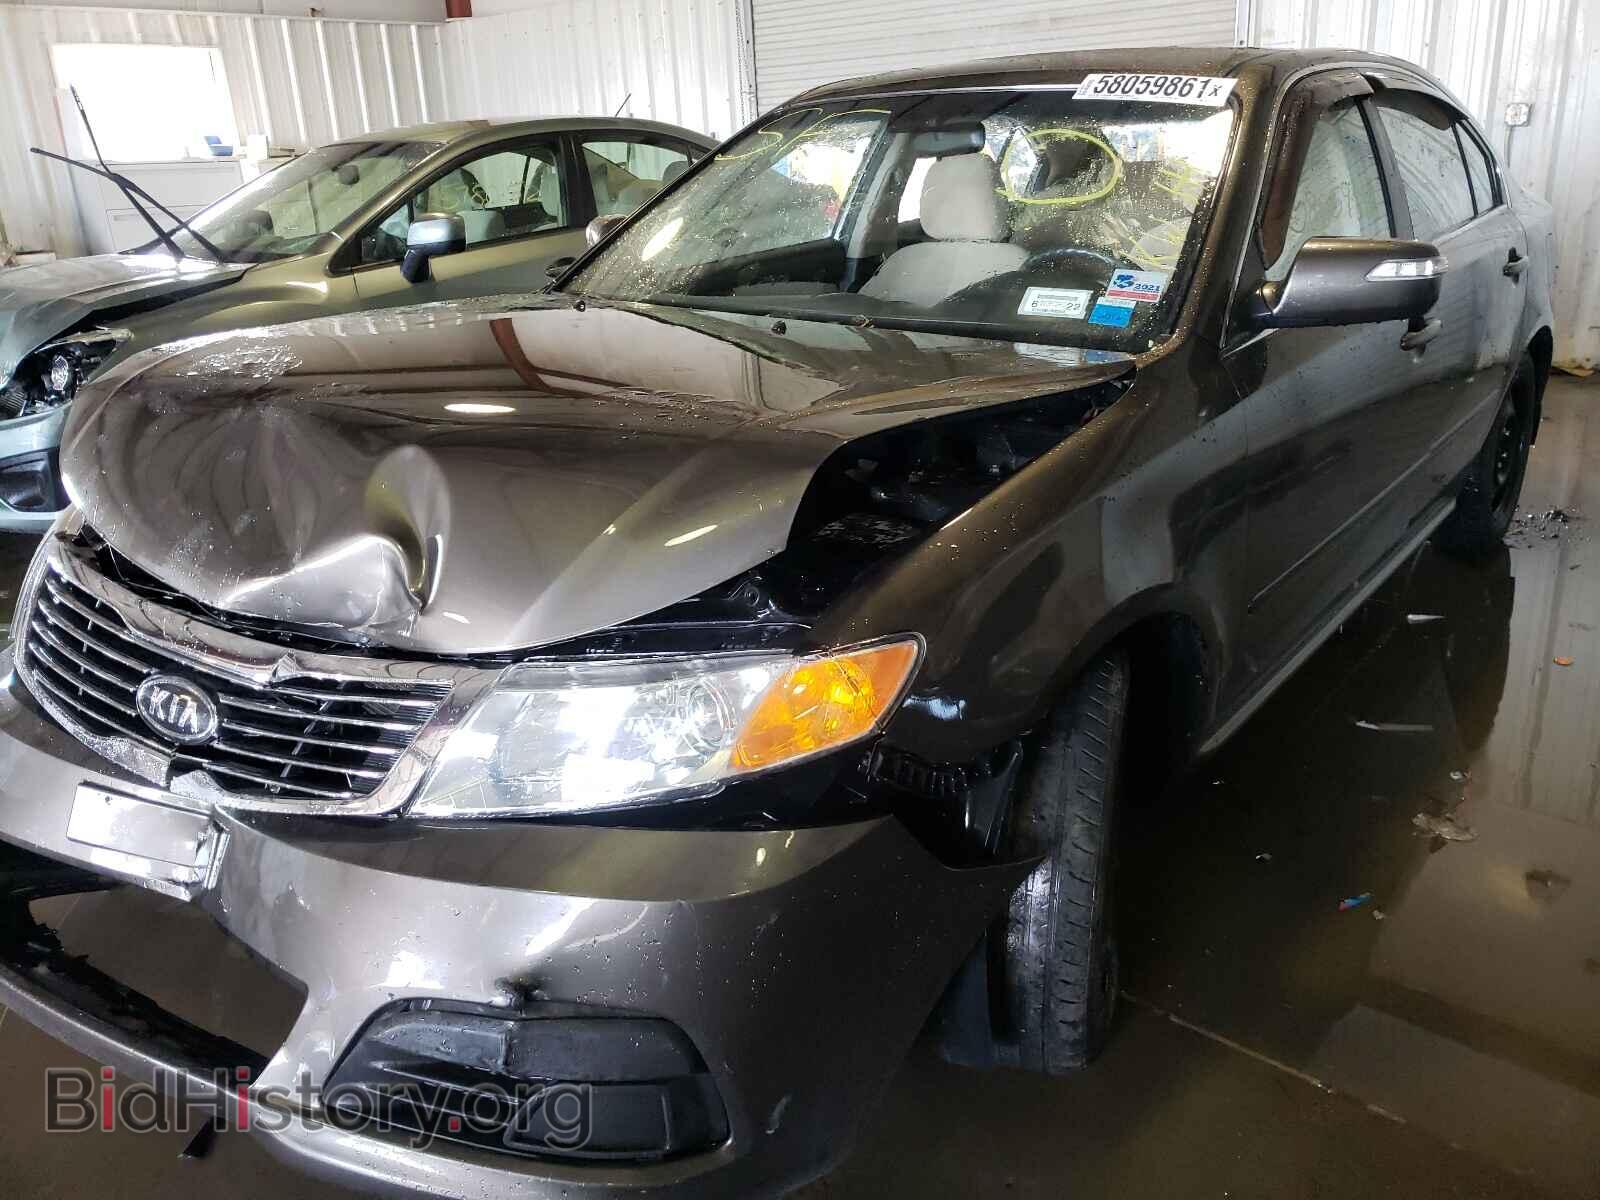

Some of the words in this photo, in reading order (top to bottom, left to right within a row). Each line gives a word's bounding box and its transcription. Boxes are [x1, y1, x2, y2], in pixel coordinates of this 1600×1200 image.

[1093, 75, 1212, 98] 58059861
[1134, 283, 1161, 291] 2021
[1066, 302, 1081, 311] 22
[148, 686, 198, 734] KIA
